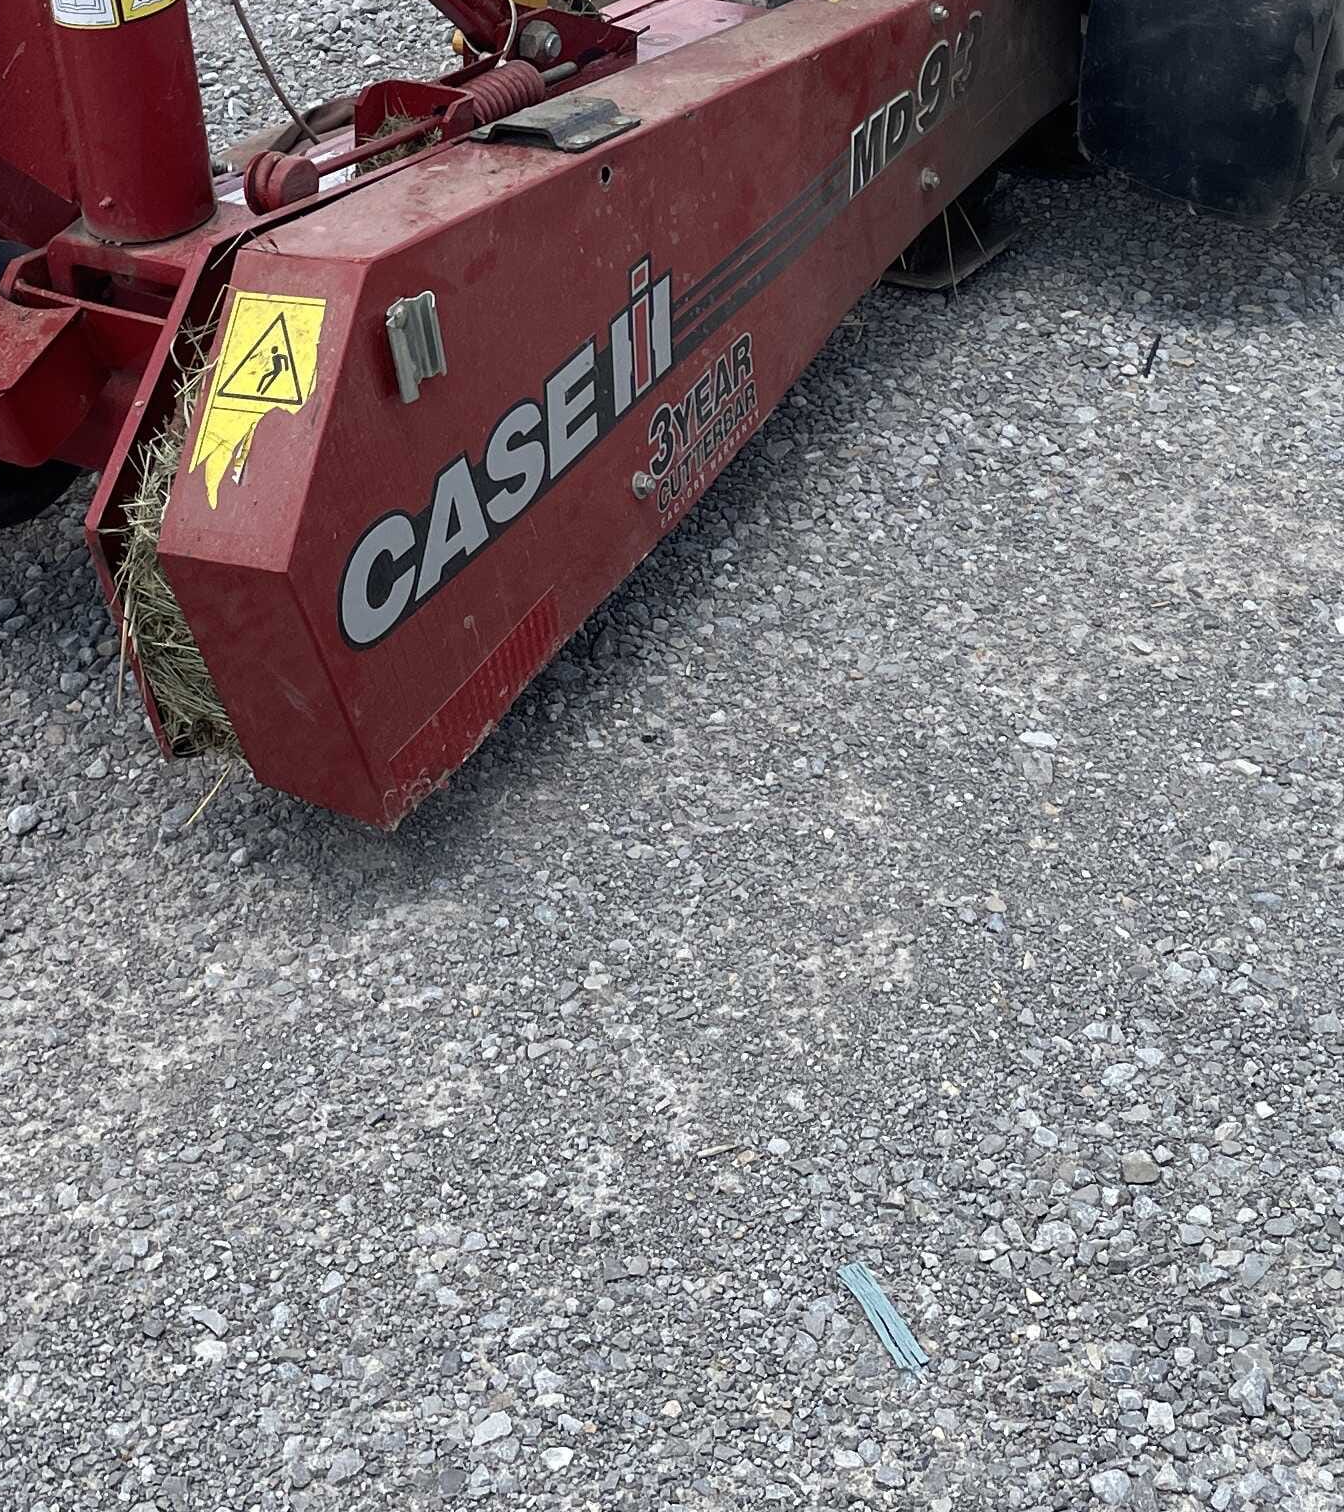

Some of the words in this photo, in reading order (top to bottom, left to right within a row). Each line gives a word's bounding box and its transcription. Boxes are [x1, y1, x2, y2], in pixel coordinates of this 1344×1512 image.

[339, 338, 600, 647] CASE
[657, 380, 758, 513] CUTTERBAR
[661, 473, 706, 528] FACTORY
[710, 409, 760, 472] WARRANTY
